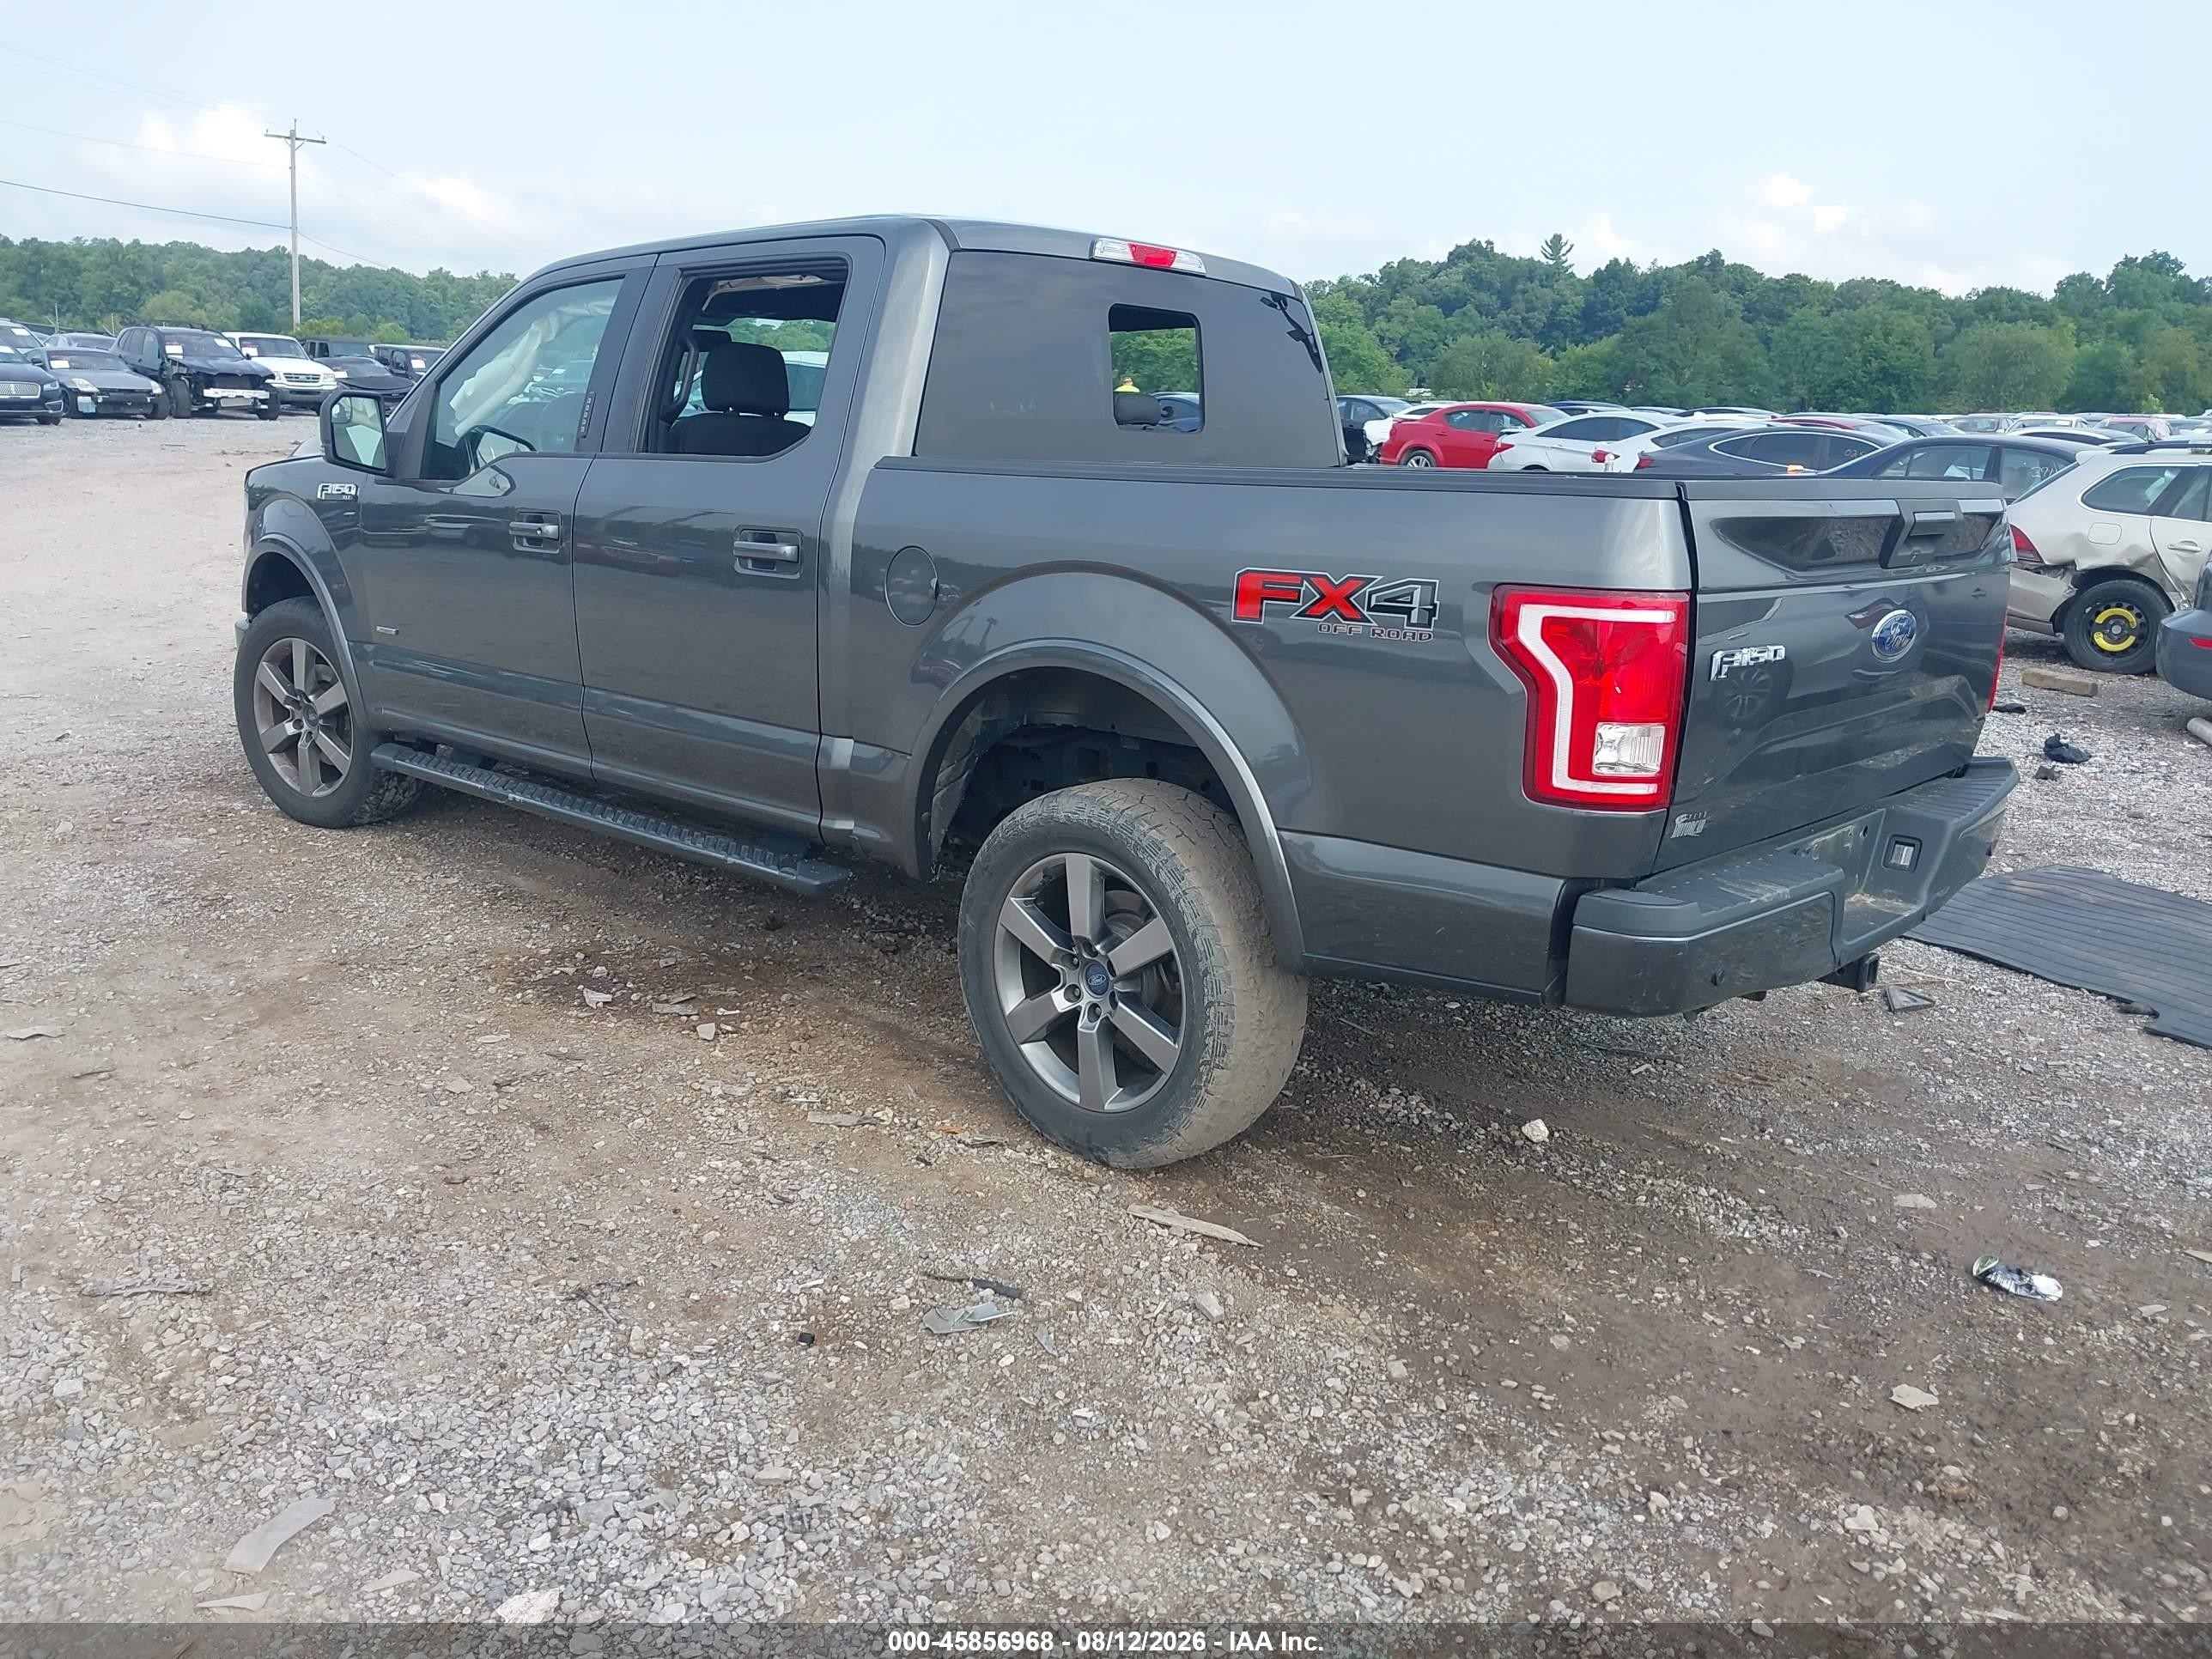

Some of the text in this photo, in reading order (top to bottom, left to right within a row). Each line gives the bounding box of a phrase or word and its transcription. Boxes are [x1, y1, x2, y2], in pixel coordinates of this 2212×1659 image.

[1231, 567, 1440, 630] FX4
[1317, 623, 1435, 642] OFF ROAD
[1885, 618, 1911, 649] Ford
